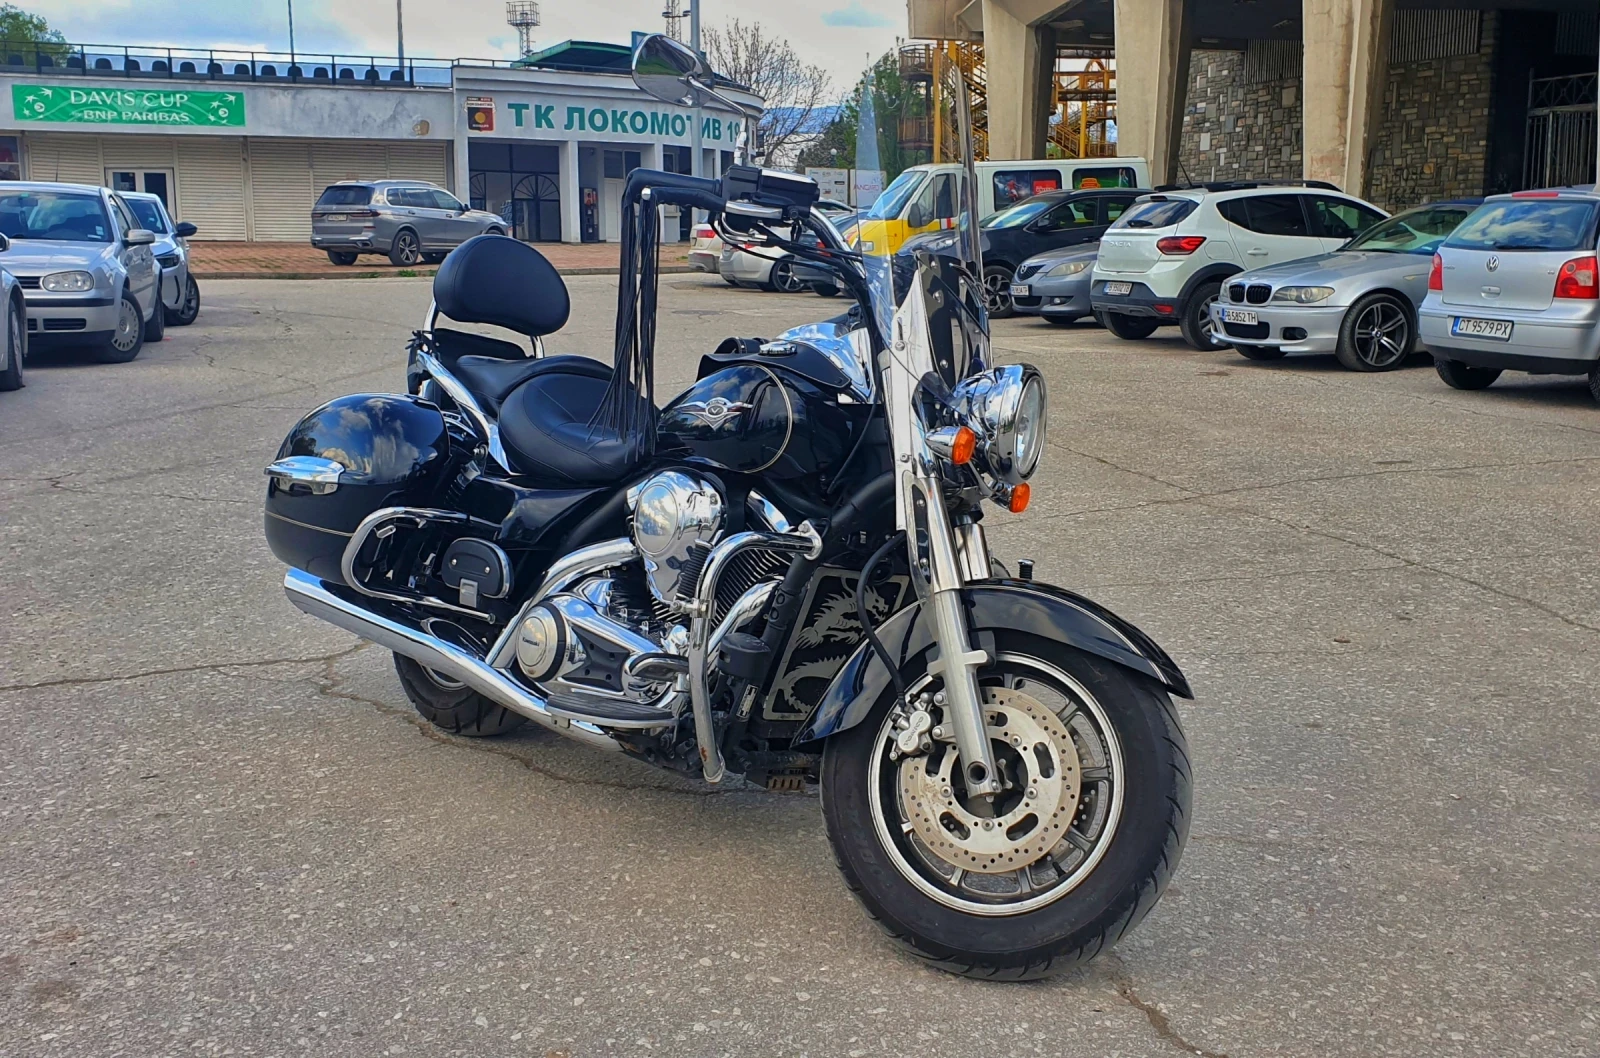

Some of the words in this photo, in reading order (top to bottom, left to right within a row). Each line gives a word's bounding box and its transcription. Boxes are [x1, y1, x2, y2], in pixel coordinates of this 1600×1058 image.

[70, 90, 136, 106] DAVIS
[142, 92, 188, 107] CUP
[83, 109, 118, 120] BNP
[121, 111, 190, 122] PARIBAS
[507, 103, 555, 129] ТК
[563, 106, 722, 141] ЛОКОМОИВ
[1471, 320, 1495, 333] 9579
